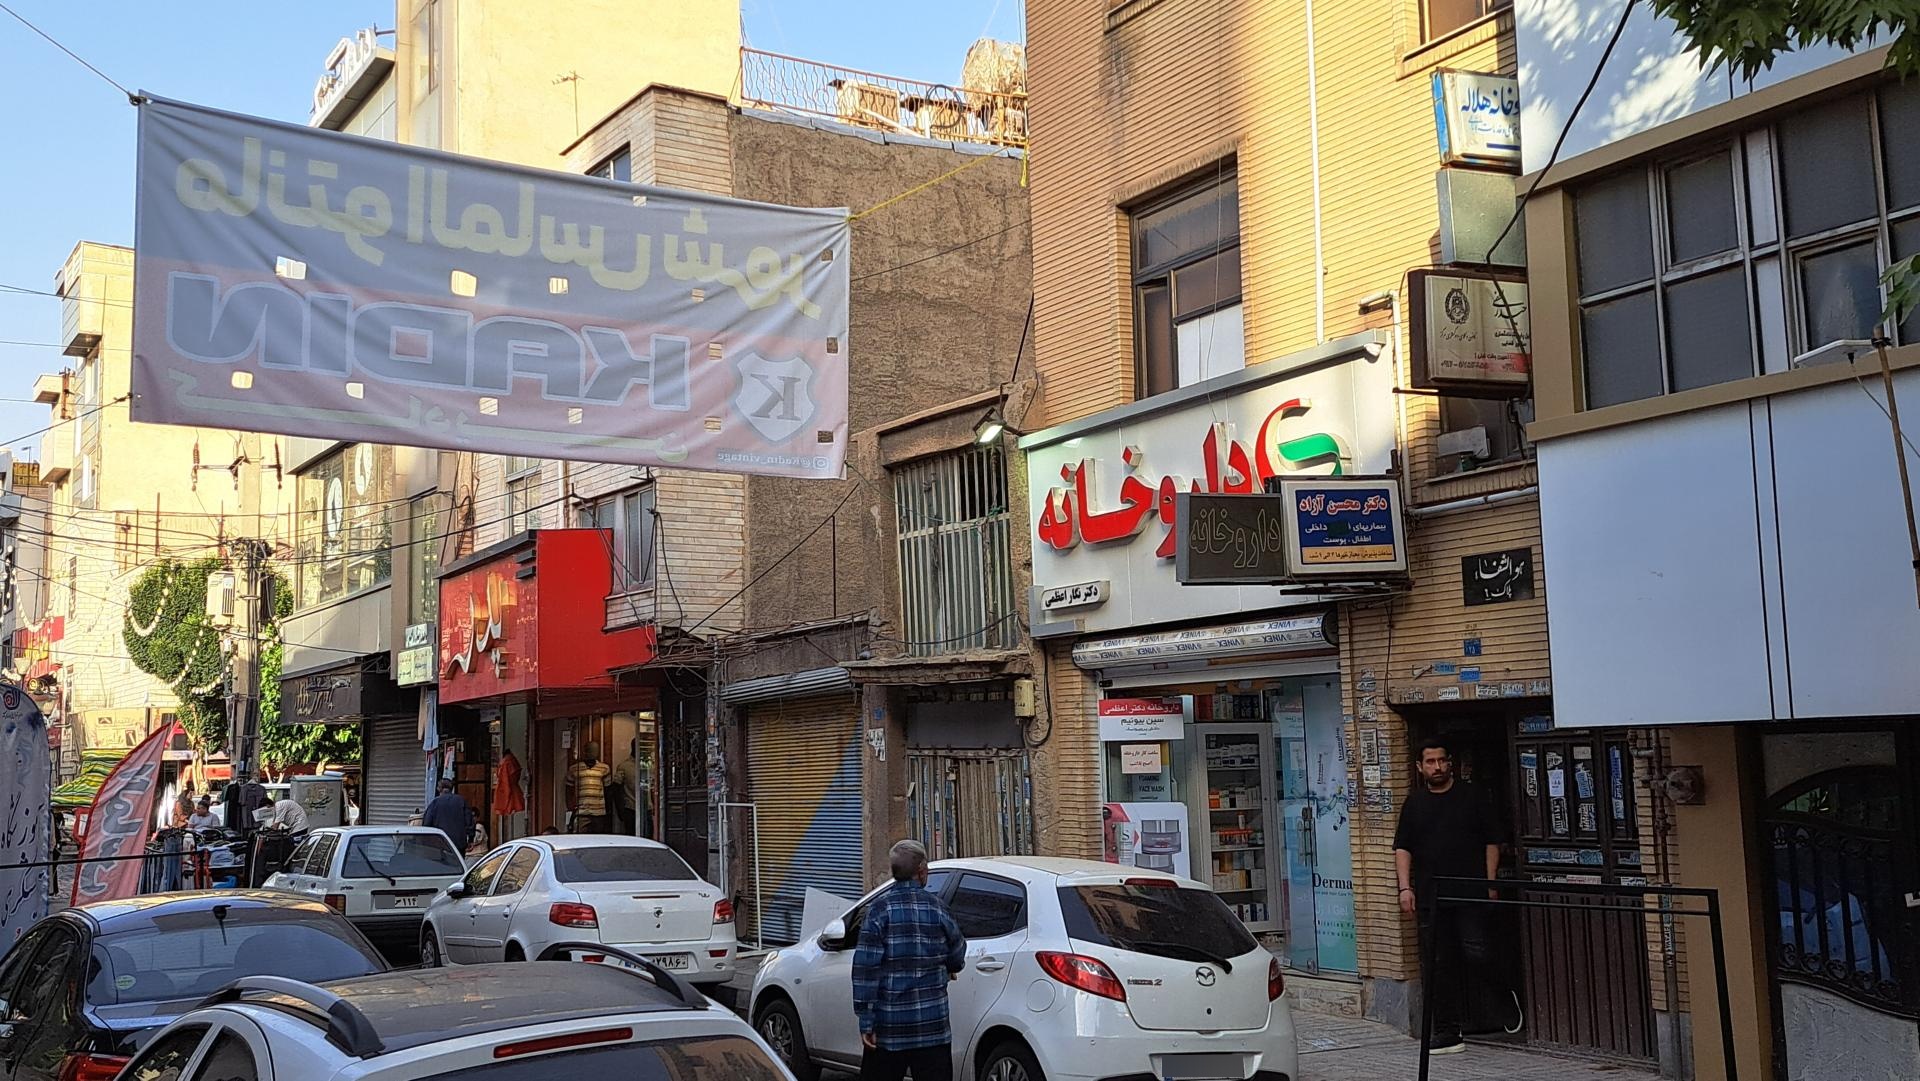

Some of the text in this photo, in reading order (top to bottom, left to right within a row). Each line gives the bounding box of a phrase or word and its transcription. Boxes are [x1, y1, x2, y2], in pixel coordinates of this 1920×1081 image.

[1038, 422, 1253, 558] داوخانه
[1300, 494, 1387, 516] دکتر محسن آزاد
[1305, 523, 1328, 534] داخلی
[1352, 522, 1386, 532] بیماریهای
[1189, 507, 1281, 568] داروخانه
[1045, 584, 1098, 608] دکتر نگار اعظمی
[1491, 579, 1512, 598] پلاک
[1104, 704, 1128, 714] اعظمی
[1128, 704, 1146, 714] دکتر
[1314, 872, 1353, 890] Derma
